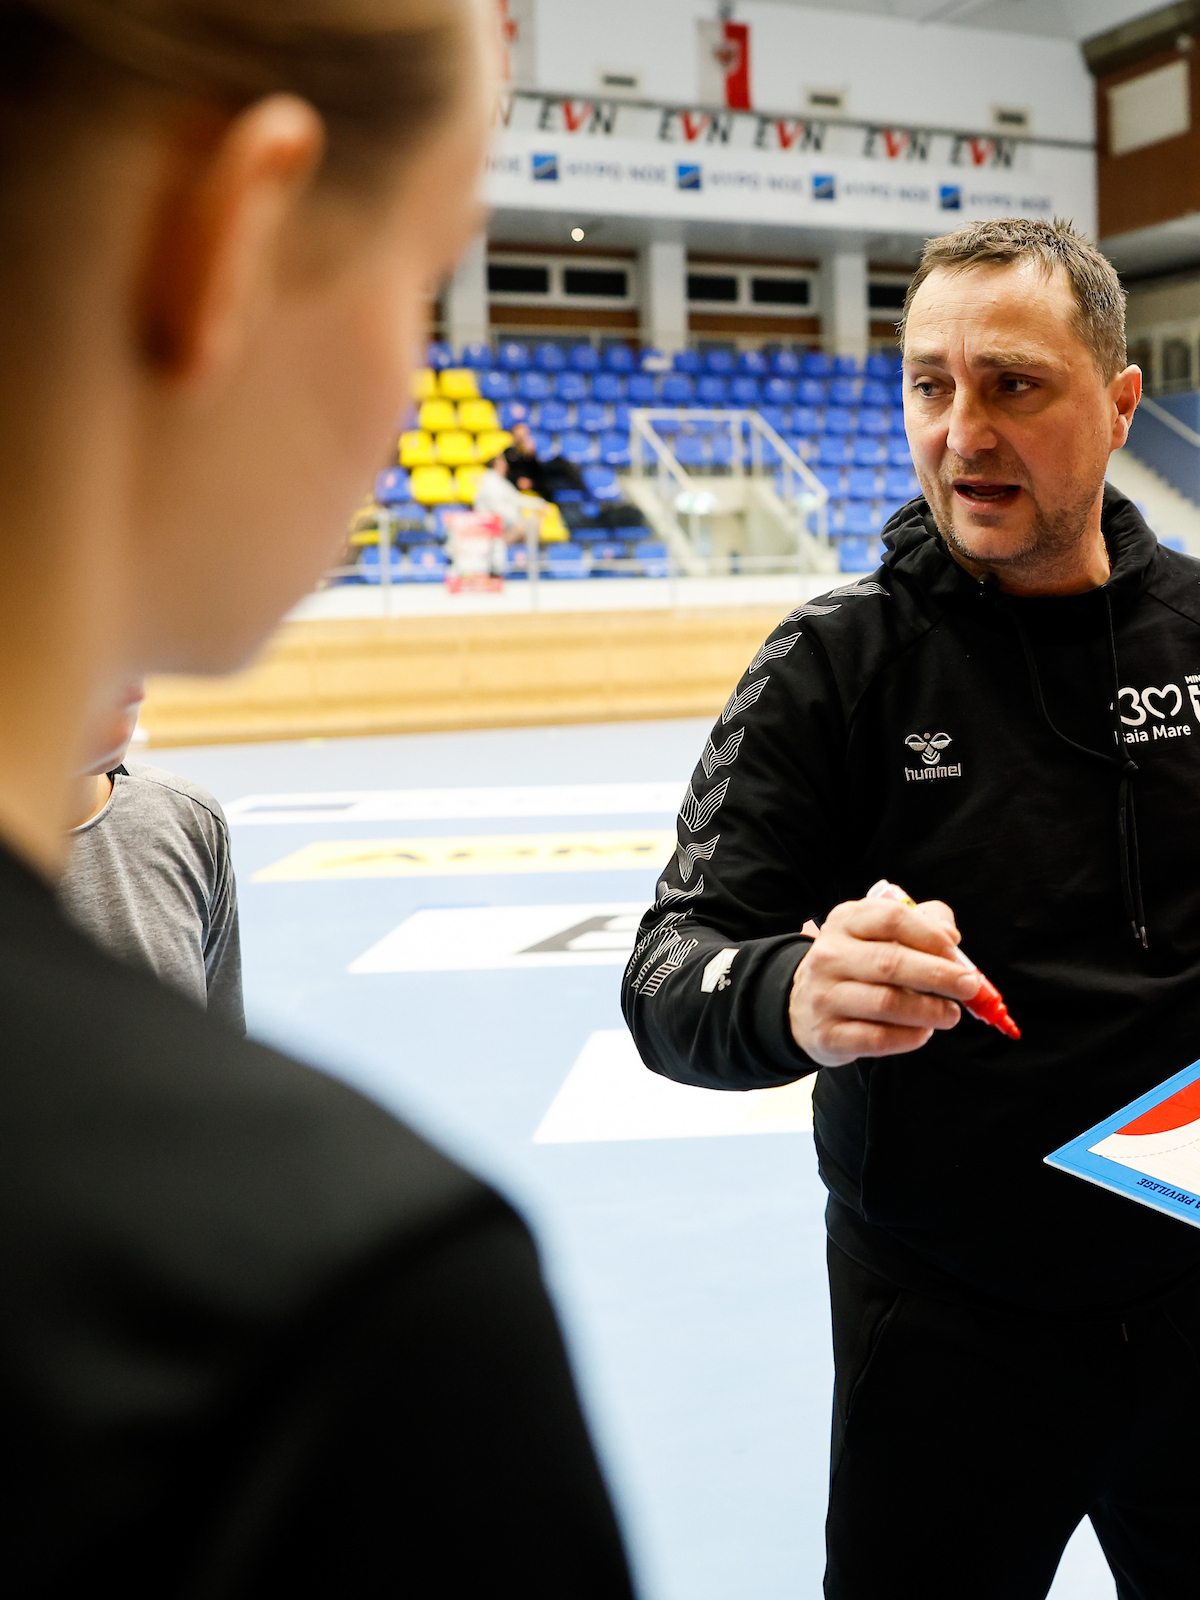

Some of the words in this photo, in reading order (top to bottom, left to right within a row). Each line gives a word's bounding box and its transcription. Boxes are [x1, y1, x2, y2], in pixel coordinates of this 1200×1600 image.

[537, 98, 617, 134] EVN
[657, 108, 733, 143] EVN
[754, 115, 827, 151] EVN
[863, 126, 932, 161] EVN
[949, 133, 1018, 169] EVN
[1152, 724, 1191, 740] Mare
[904, 762, 961, 781] hummel
[1136, 1177, 1195, 1206] PRIVILEGE
